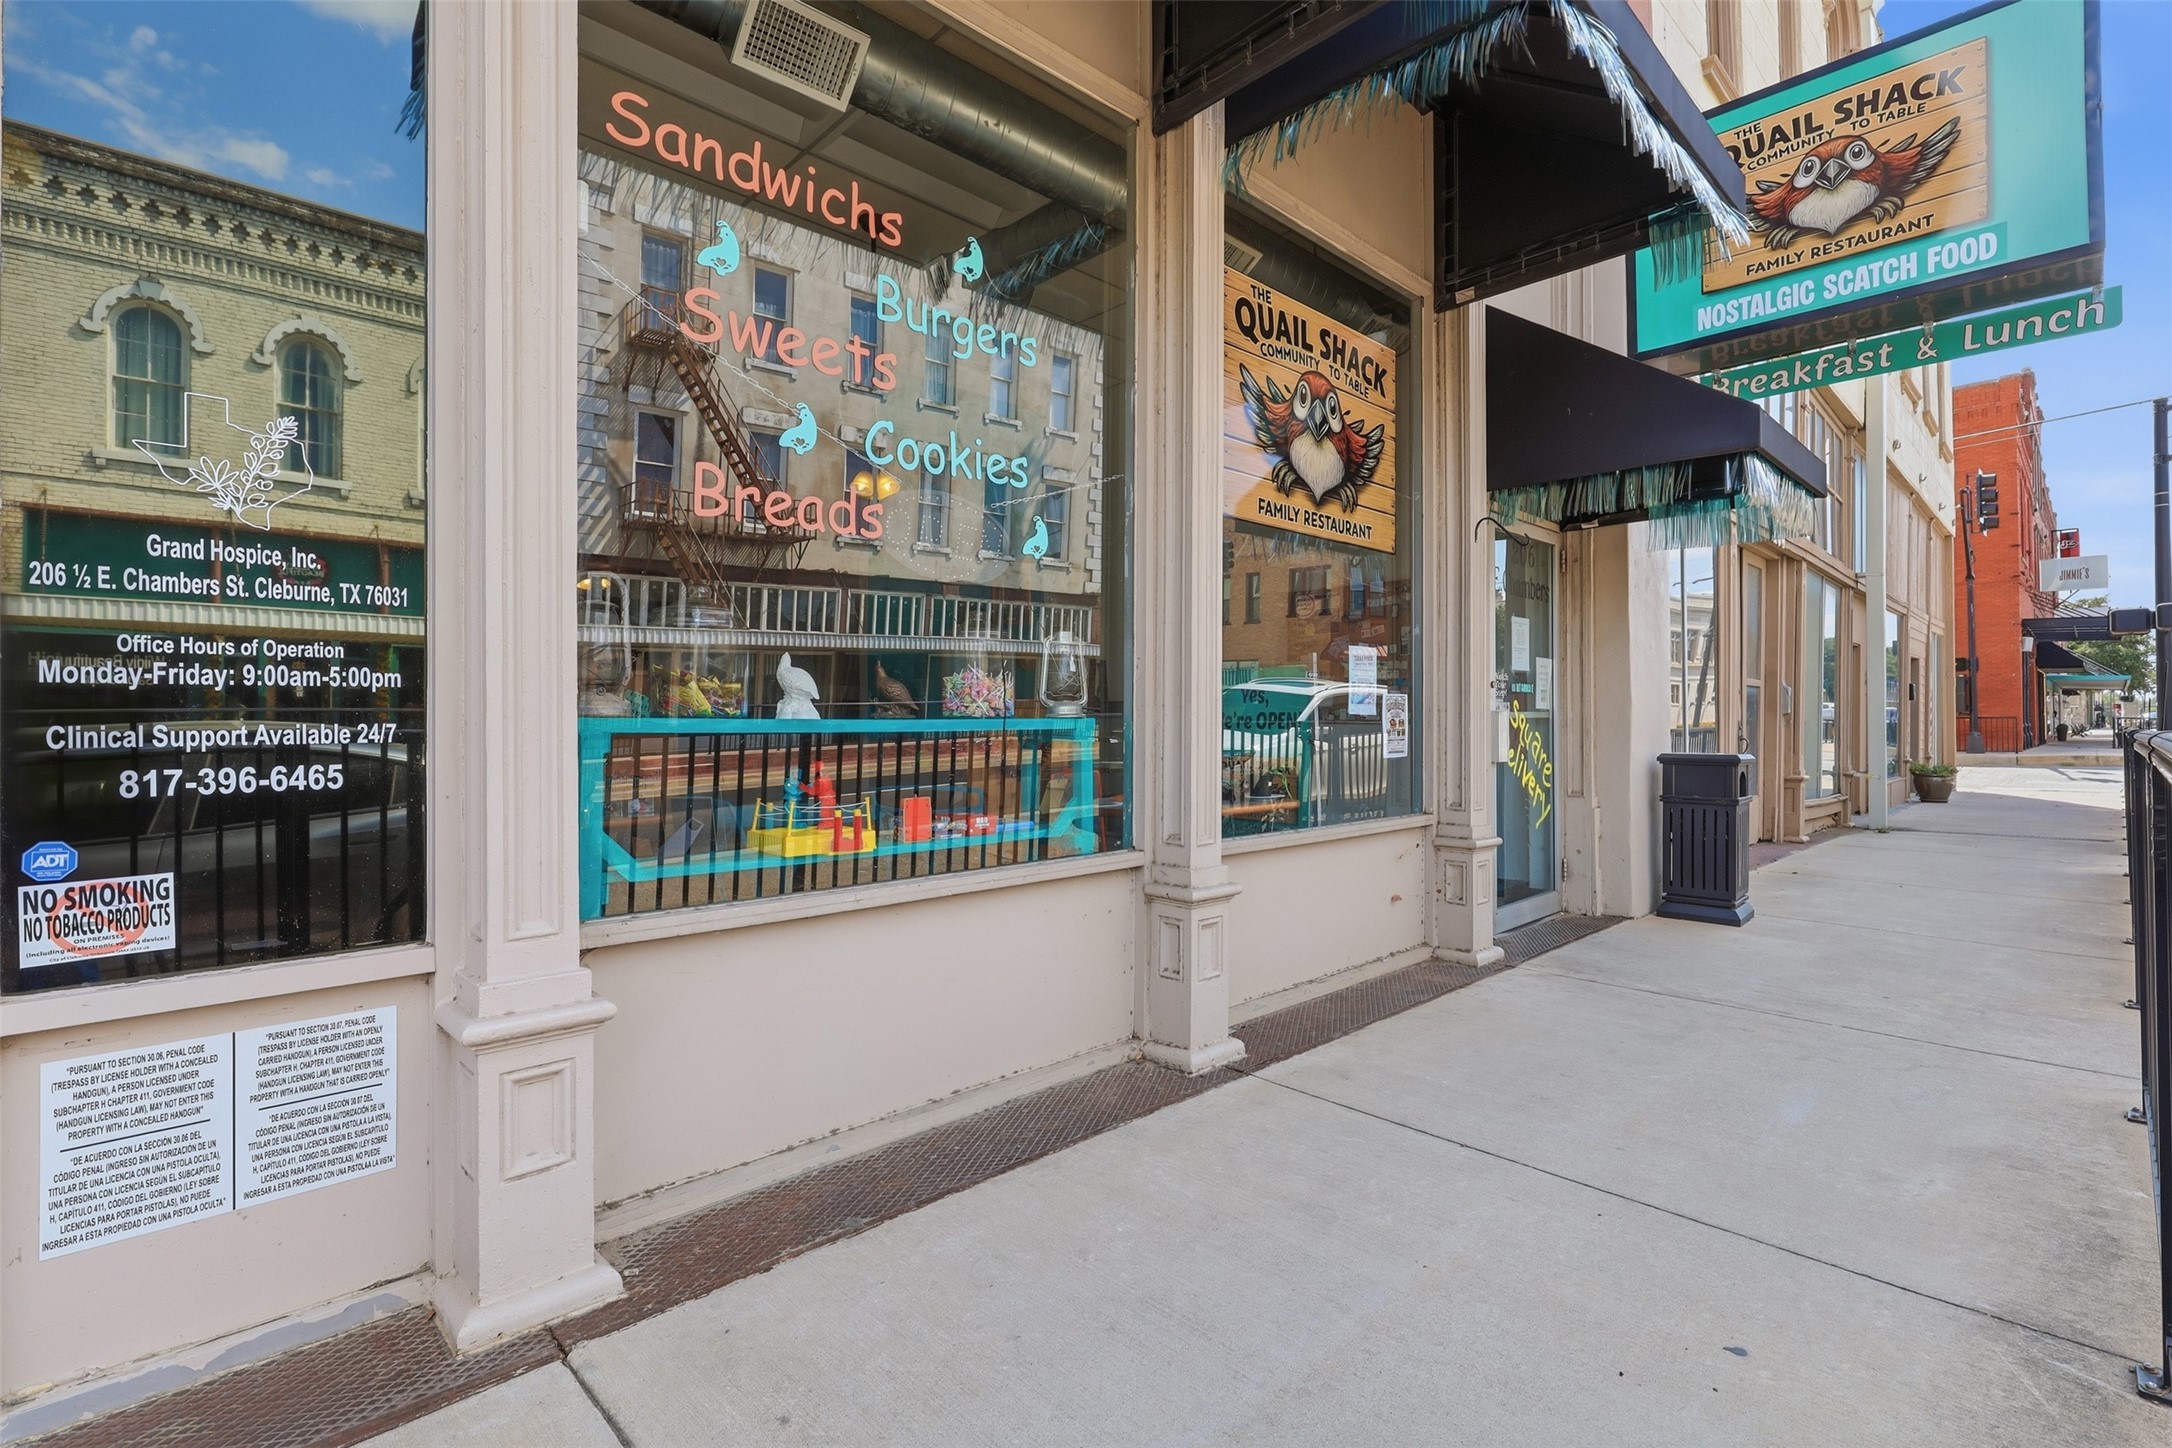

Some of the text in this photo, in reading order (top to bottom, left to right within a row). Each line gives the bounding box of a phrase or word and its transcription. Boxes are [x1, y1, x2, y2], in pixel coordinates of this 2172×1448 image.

[1834, 66, 1966, 126] SHACK
[1734, 122, 1762, 140] THE
[1747, 101, 1926, 171] COMMUNITY TO TABLE
[606, 91, 903, 246] Sandwichs
[1746, 214, 1934, 276] FAMILY RESTAURANT
[1250, 284, 1271, 304] THE
[1698, 232, 1998, 331] NOSTALGIC SCATCH FOOD
[877, 274, 1038, 367] Burgers
[679, 288, 897, 391] Sweets
[1235, 296, 1388, 398] QUAIL SHACK
[1712, 299, 2105, 399] Breakfast & Lunch
[1260, 343, 1370, 398] COMMUNITY TO TABLE
[864, 420, 1029, 488] Cookies
[693, 462, 883, 539] Breads
[1258, 498, 1372, 540] FAMILY RESTAURANT
[147, 534, 321, 570] Grand Hospice, Inc.
[29, 561, 66, 586] 206
[98, 566, 116, 589] E.
[123, 567, 218, 596] Chambers
[226, 574, 248, 598] St.
[255, 577, 335, 605] Cleburne,
[340, 583, 361, 605] TX
[366, 586, 408, 607] 76031
[2059, 567, 2090, 581] JIMMIE'S
[117, 634, 344, 662] Office Hours of Operation
[39, 660, 235, 691] Monday-Friday:
[243, 663, 402, 690] 9:00am-5:00pm
[1241, 689, 1269, 708] Yes,
[1222, 711, 1252, 729] e're
[46, 724, 397, 752] Clinical Support Available 24/7
[1510, 700, 1553, 788] Square
[119, 764, 343, 798] 817-396-6465
[32, 854, 68, 869] ADT
[23, 878, 170, 915] NO SMOKING
[23, 903, 170, 943] NO TOBACCO PRODUCTS
[87, 933, 125, 943] PREMISES
[77, 942, 114, 952] electronic
[107, 1059, 116, 1068] TO
[187, 1044, 205, 1054] CODE
[90, 1075, 99, 1084] BY
[158, 1062, 174, 1072] WITH
[174, 1061, 179, 1069] A
[100, 1100, 106, 1108] H
[197, 1078, 214, 1090] CODE
[111, 1085, 116, 1093] A
[149, 1101, 163, 1111] MAY
[164, 1098, 177, 1108] NOT
[200, 1091, 214, 1101] THIS
[105, 1122, 122, 1133] WITH
[123, 1121, 128, 1129] A
[118, 1145, 132, 1156] CON
[134, 1143, 142, 1152] LA
[189, 1130, 202, 1140] DEL
[138, 1154, 149, 1164] SIN
[197, 1141, 206, 1151] DE
[207, 1139, 216, 1149] UN
[48, 1199, 63, 1211] UNA
[98, 1188, 113, 1199] CON
[168, 1173, 177, 1182] EL
[78, 1180, 88, 1191] DE
[89, 1177, 104, 1188] UNA
[136, 1166, 150, 1177] CON
[151, 1163, 165, 1174] UNA
